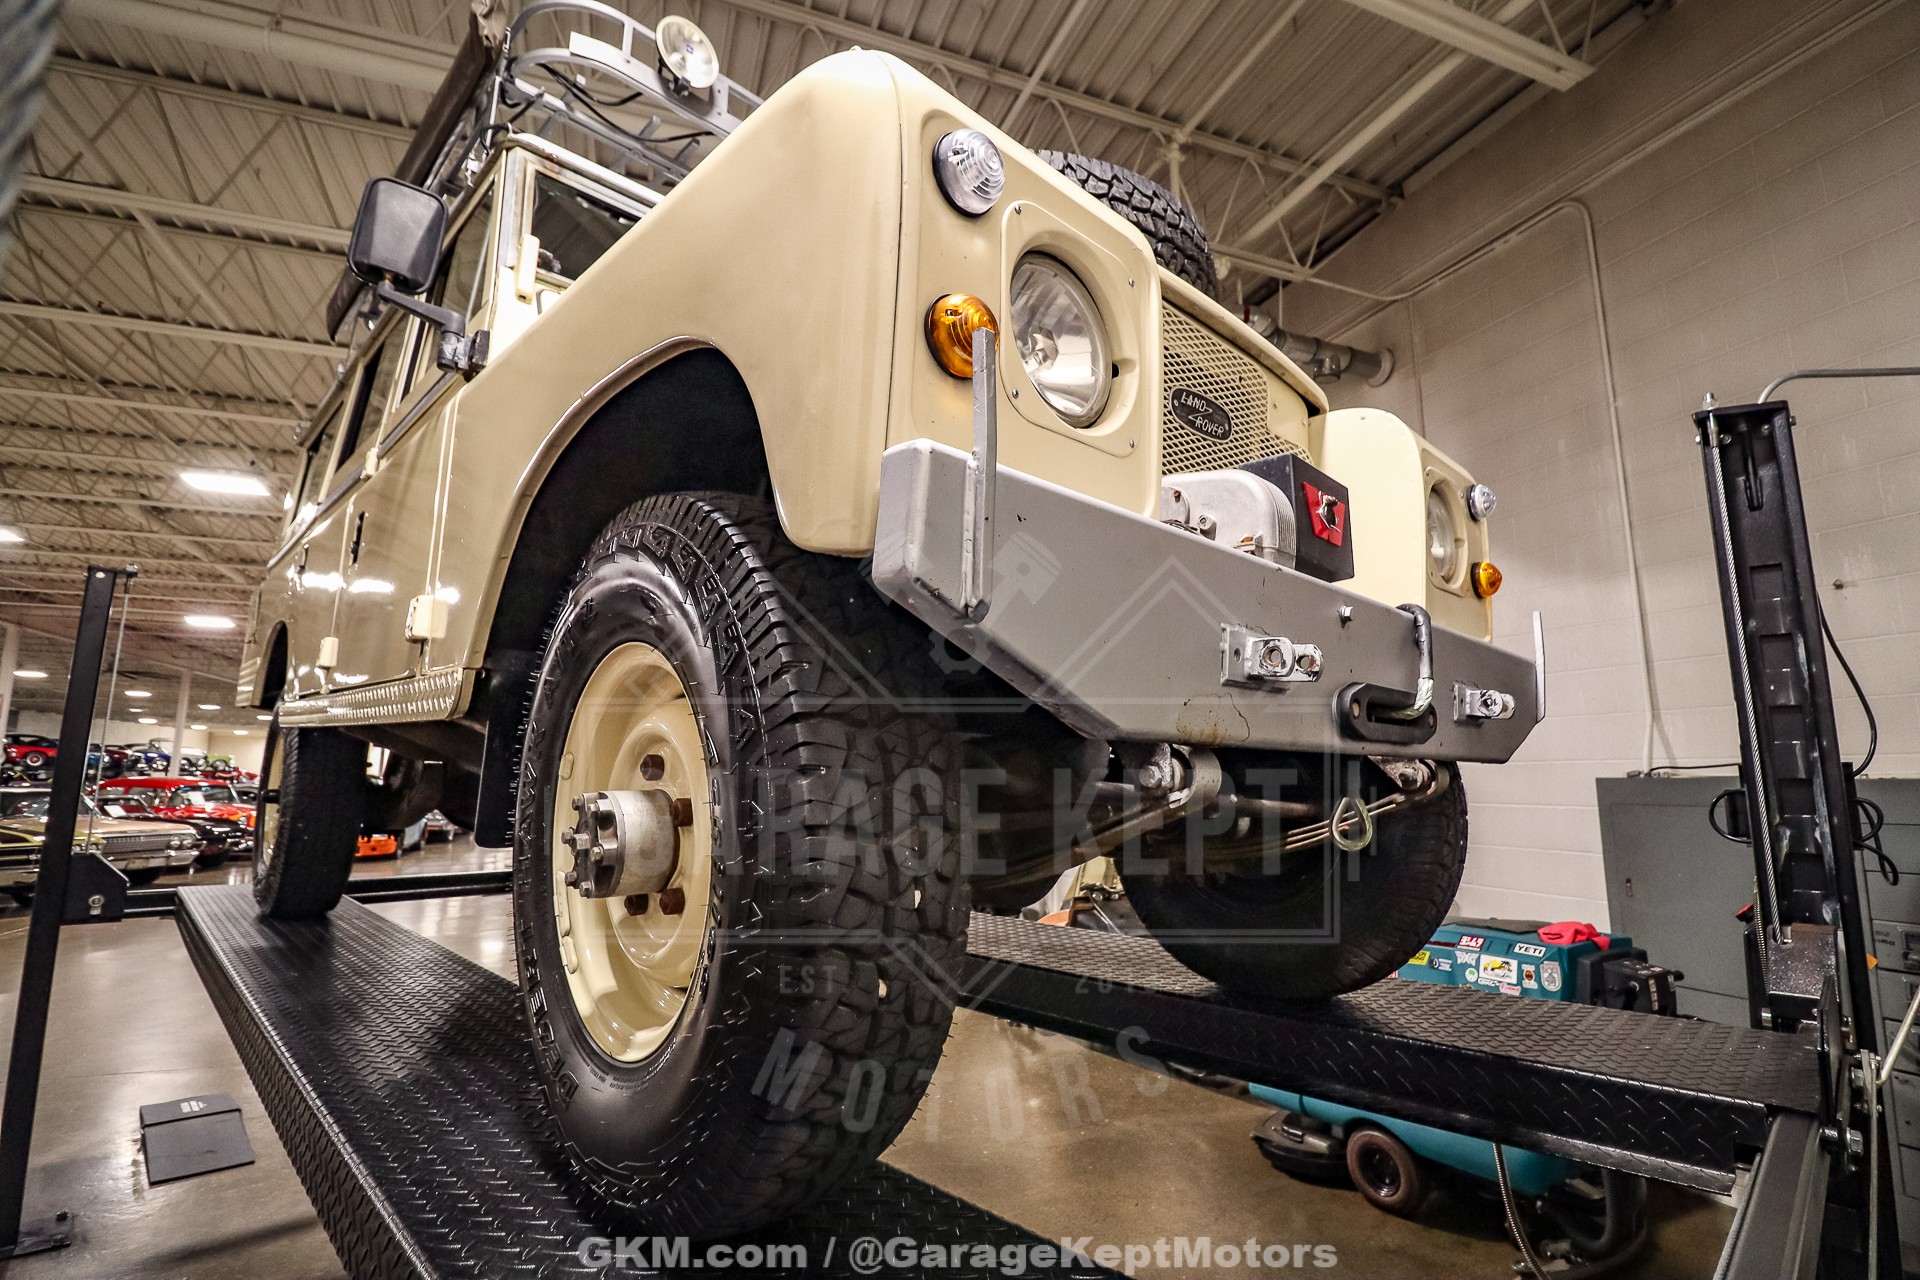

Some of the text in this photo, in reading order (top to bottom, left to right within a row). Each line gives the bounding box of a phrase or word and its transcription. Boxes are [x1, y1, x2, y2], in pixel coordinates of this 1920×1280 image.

[1181, 391, 1207, 412] LAND
[1195, 416, 1225, 437] ROVER
[1517, 944, 1543, 955] YETI
